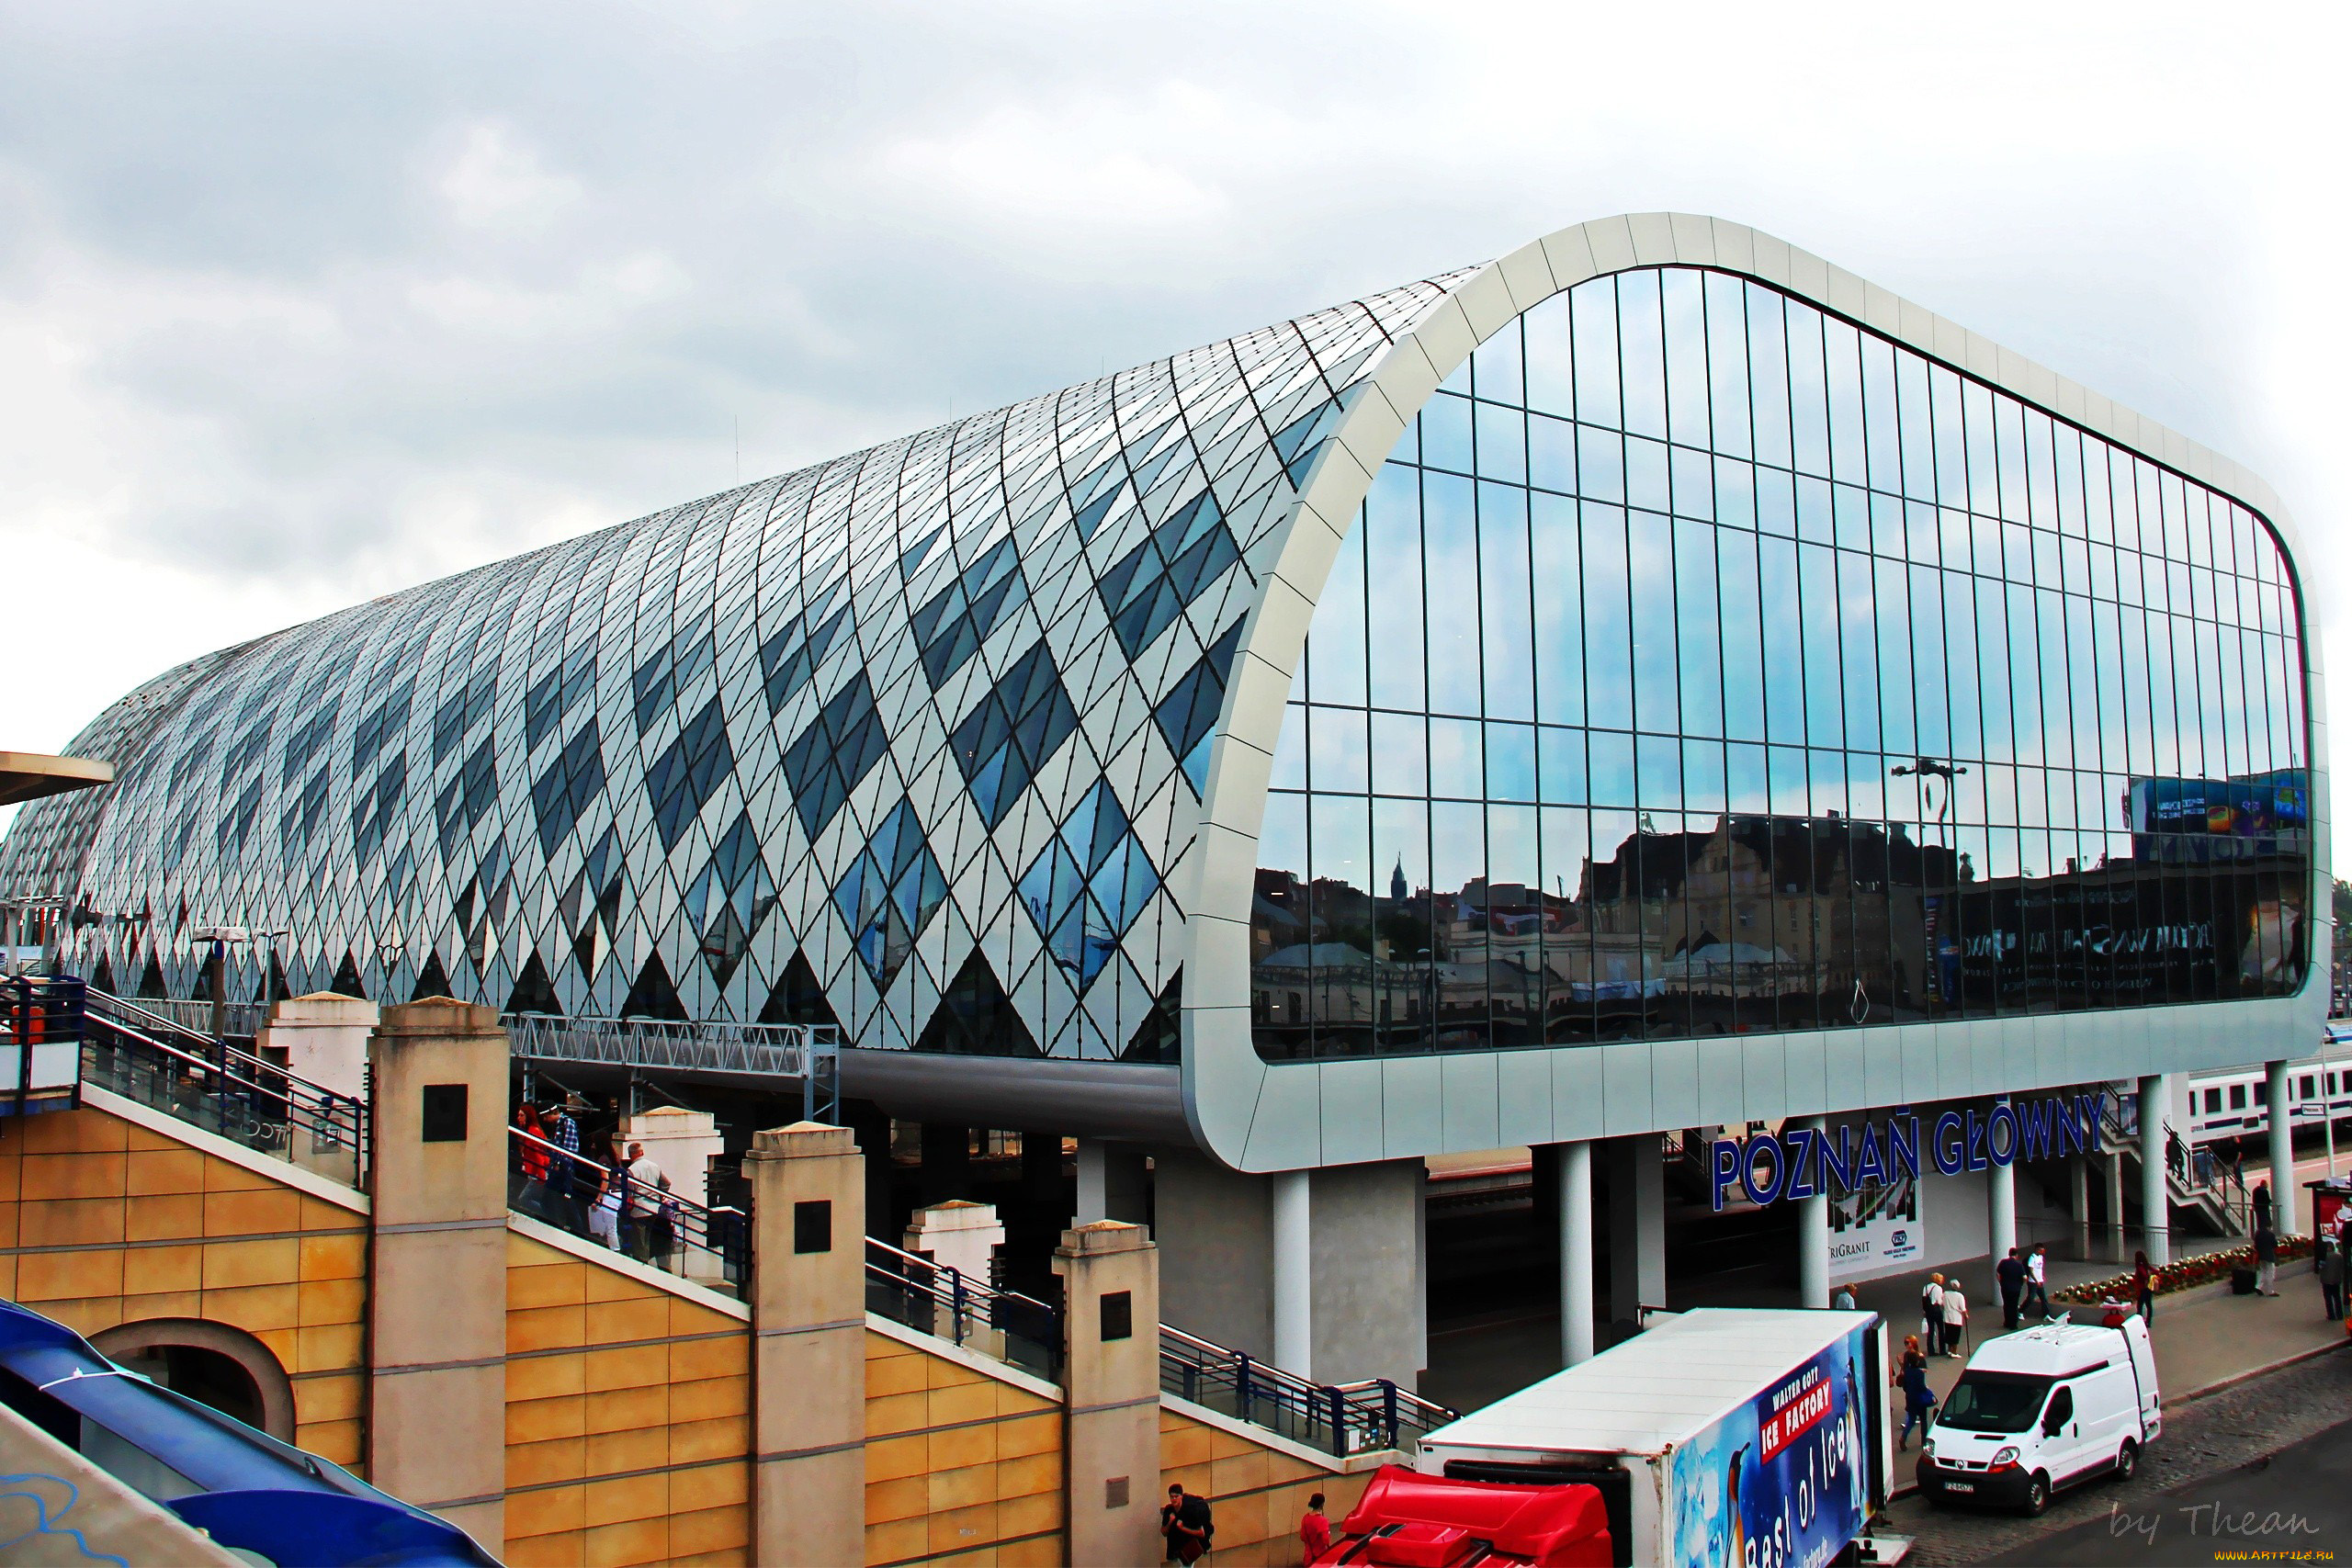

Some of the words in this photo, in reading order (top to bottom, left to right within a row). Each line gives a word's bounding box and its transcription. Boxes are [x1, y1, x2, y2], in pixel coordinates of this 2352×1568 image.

[1713, 1105, 1919, 1212] POZNAŃ
[1934, 1093, 2106, 1176] GŁÓWNY
[1761, 1420, 1779, 1455] ICE
[1785, 1382, 1829, 1437] FACTORY
[1772, 1379, 1801, 1412] WALTER
[1802, 1366, 1818, 1391] GOTT
